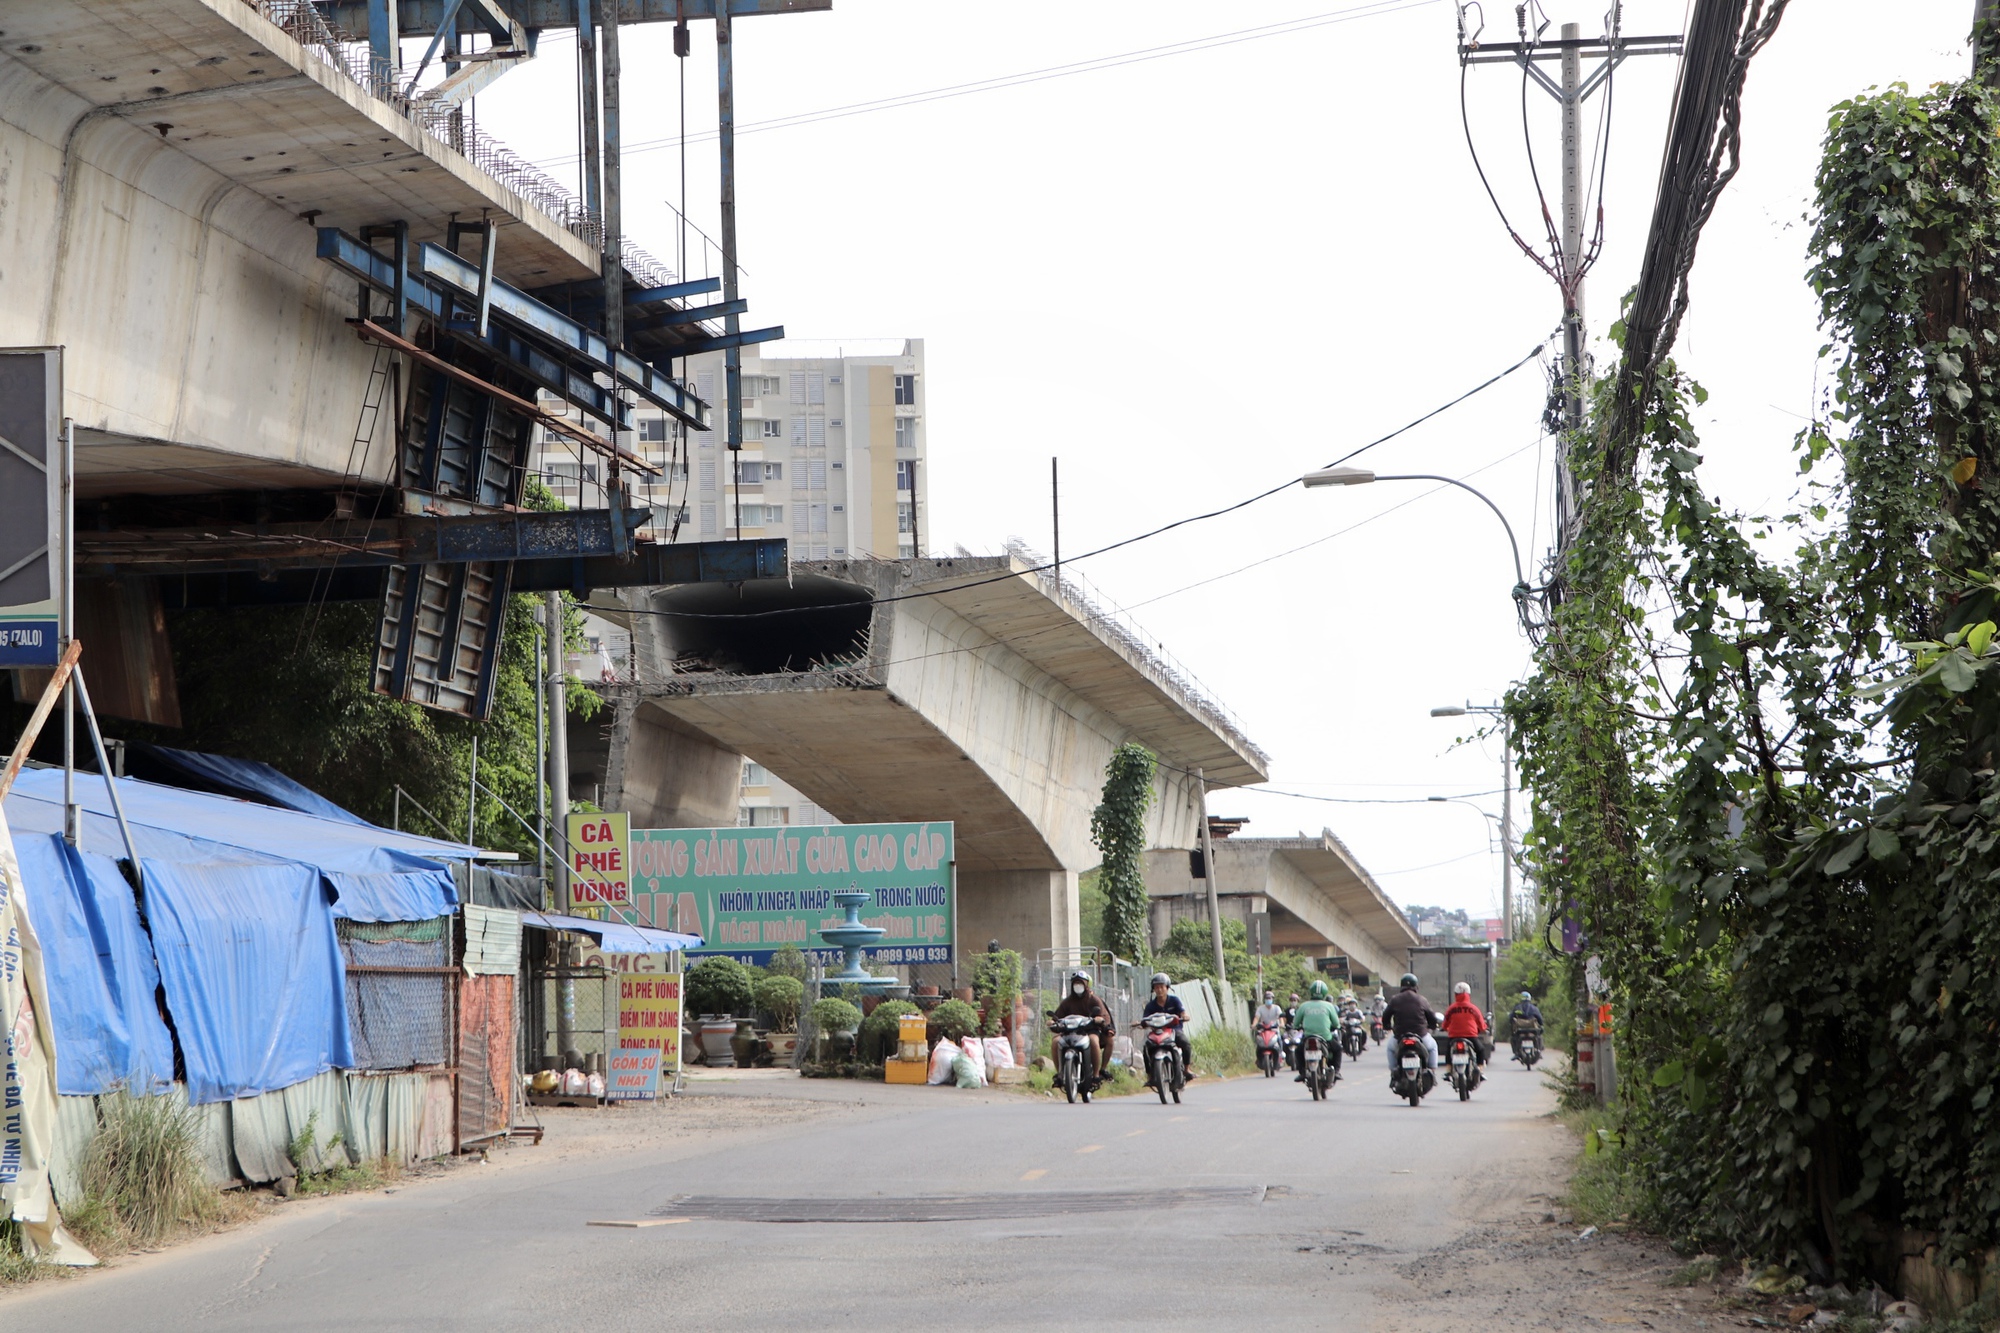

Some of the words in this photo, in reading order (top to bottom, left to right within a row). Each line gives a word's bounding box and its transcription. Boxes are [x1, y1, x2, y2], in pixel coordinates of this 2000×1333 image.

[10, 629, 43, 648] (ZALO)
[581, 819, 614, 843] CÀ
[575, 848, 622, 872] PHÊ
[694, 829, 738, 877] SẢN
[743, 827, 800, 876] XUẤT
[805, 827, 850, 875] CỬA
[854, 833, 898, 873] CAO
[903, 823, 946, 872] CẤP
[572, 879, 627, 902] VÕNG
[719, 887, 754, 912] NHÔM
[757, 890, 797, 912] XINGFA
[800, 885, 830, 913] NHẬP
[874, 887, 912, 909] TRONG
[915, 882, 946, 907] NƯỚC
[719, 916, 760, 944] VÁCH
[763, 915, 807, 942] NGĂN
[917, 913, 946, 942] LỰC
[876, 948, 902, 962] 0989
[905, 948, 925, 961] 949
[928, 947, 947, 961] 939
[621, 978, 633, 999] CÀ
[635, 978, 653, 999] PHÊ
[655, 979, 679, 999] VÕNG
[641, 1008, 656, 1028] TÂM
[658, 1007, 679, 1028] SÁNG
[663, 1039, 677, 1055] K+
[611, 1052, 639, 1070] GỐM
[640, 1054, 658, 1071] SỨ
[616, 1074, 649, 1089] NHẬT
[5, 1085, 25, 1109] ĐÁ
[3, 1112, 22, 1135] TỰ
[0, 1138, 23, 1184] NHIÊN
